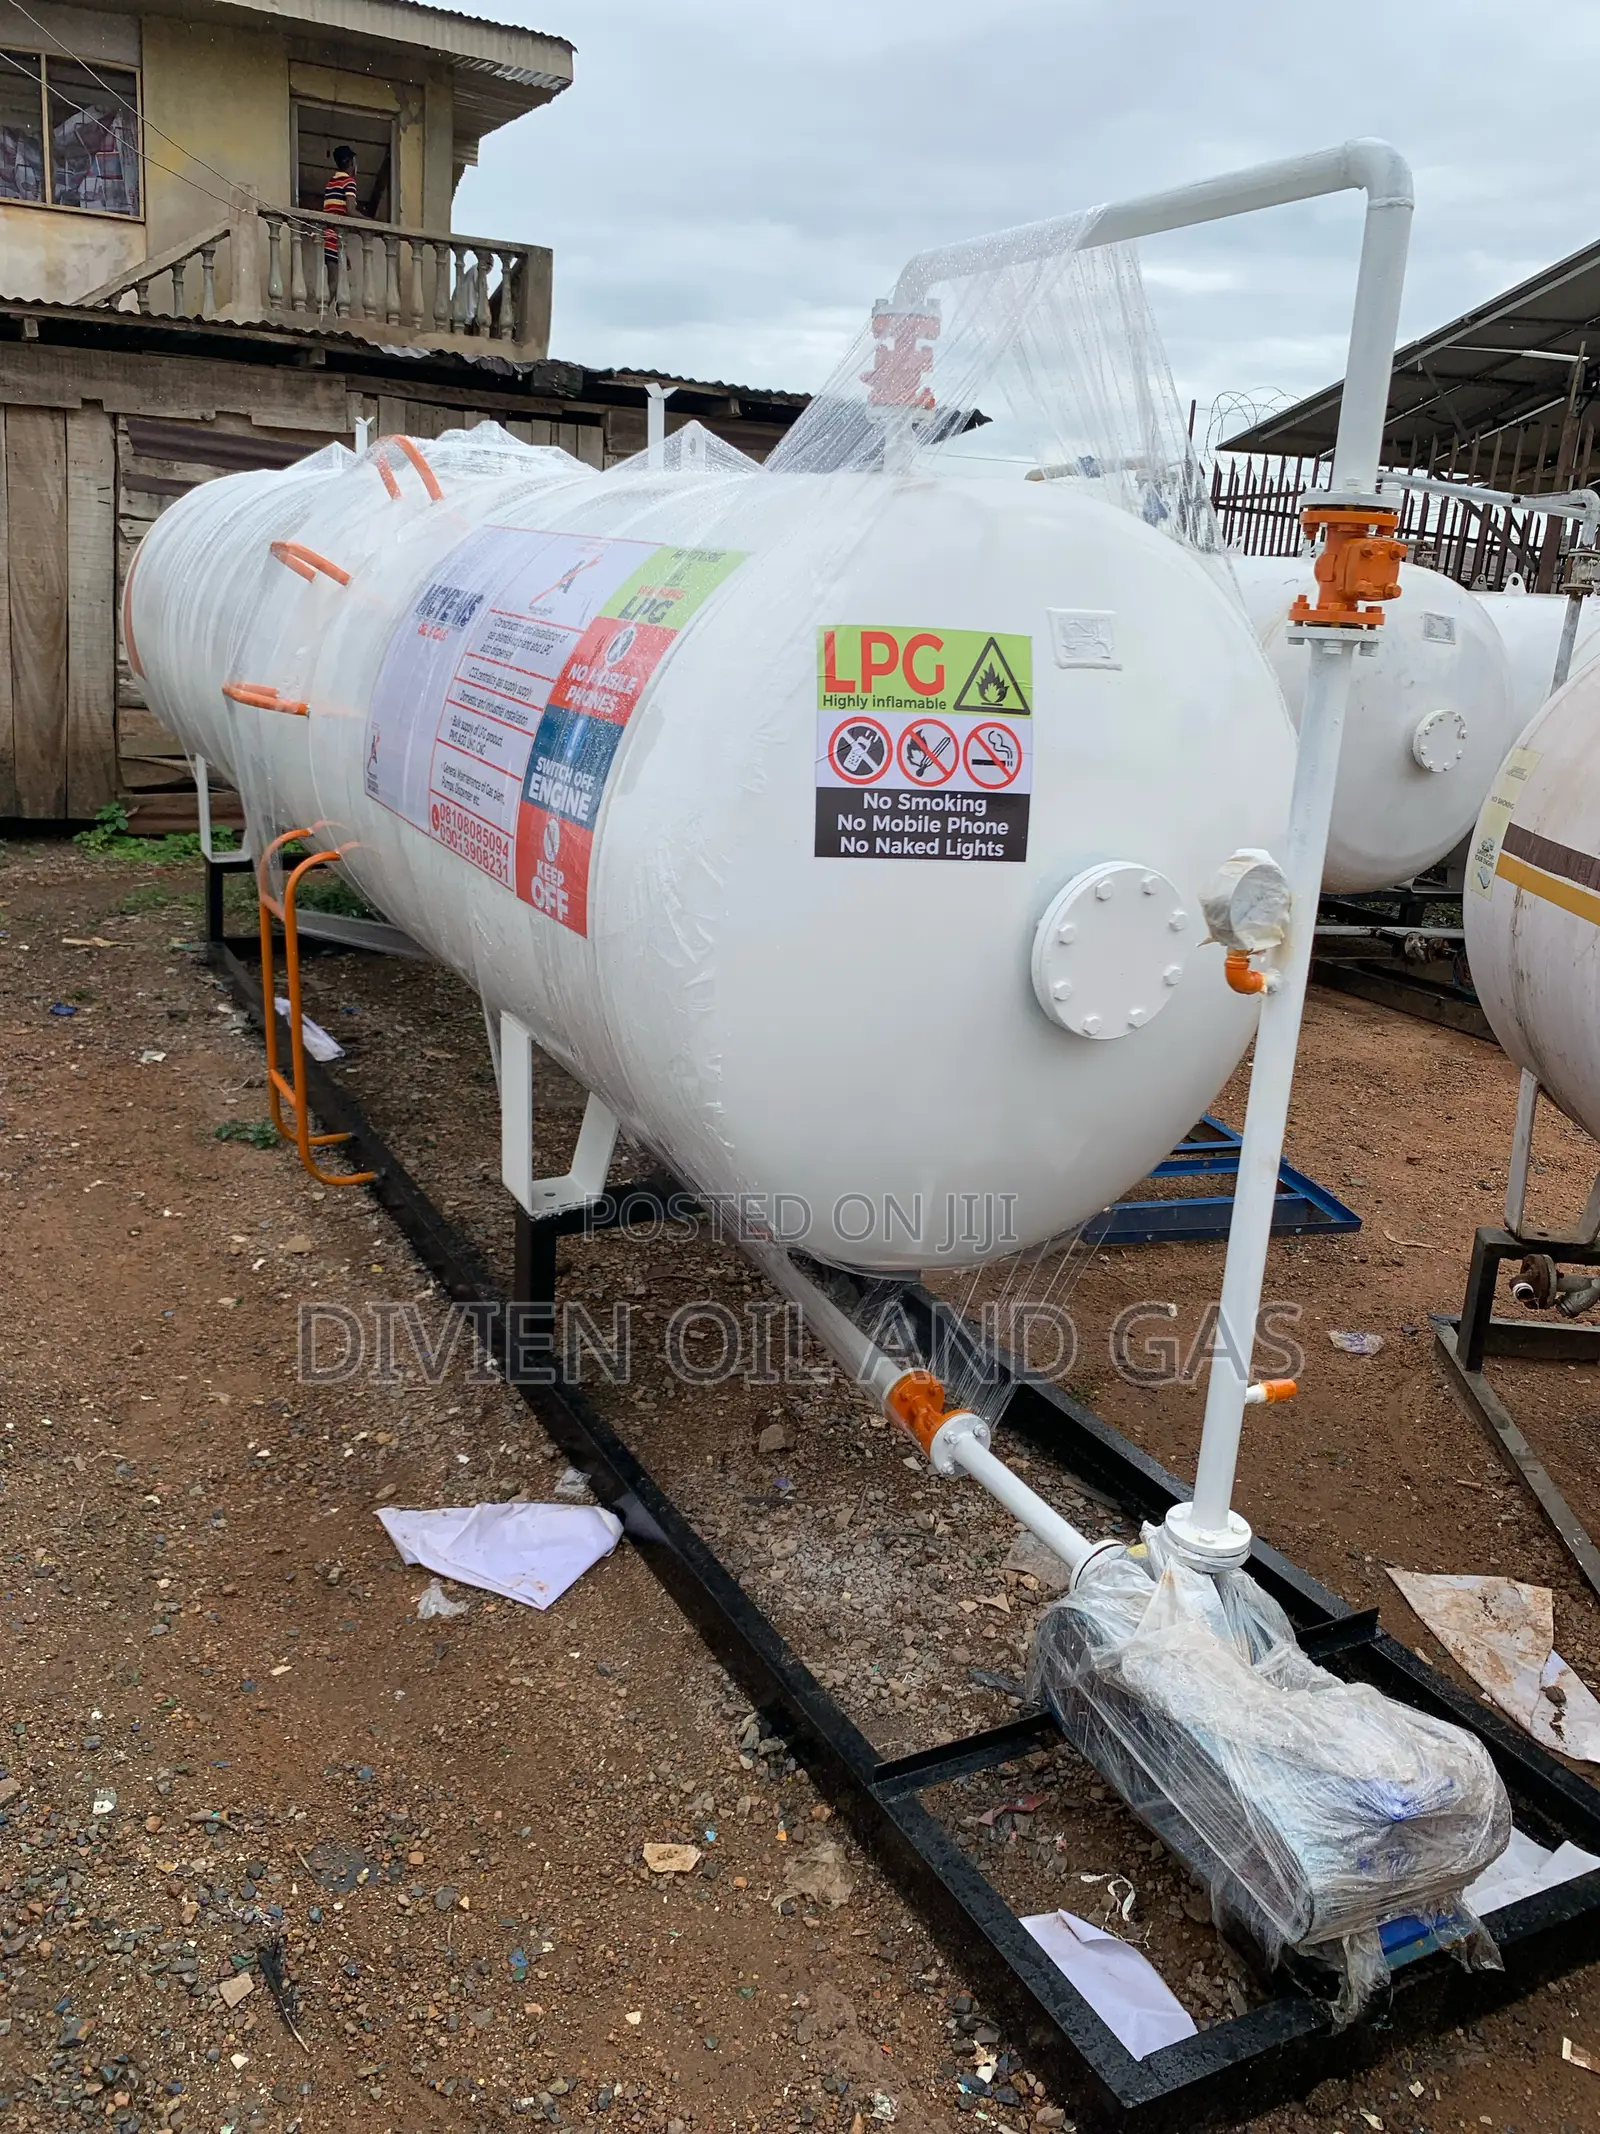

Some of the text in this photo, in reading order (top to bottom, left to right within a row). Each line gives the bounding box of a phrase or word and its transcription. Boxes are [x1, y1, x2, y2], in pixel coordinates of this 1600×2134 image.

[617, 596, 675, 624] LPG
[824, 630, 945, 696] LPG
[568, 663, 638, 695] NO MOBILE
[564, 685, 619, 714] PHONES
[823, 694, 947, 710] Highly inflamable
[536, 756, 596, 791] SWITCH OFF
[528, 773, 593, 821] ENGINE
[863, 792, 987, 816] No Smoking
[440, 803, 509, 861] 08108085094
[837, 814, 1009, 835] No Mobile Phone
[440, 823, 509, 883] 09013908231
[840, 836, 1004, 859] No Naked Lights
[537, 859, 565, 887] KEEP
[531, 875, 569, 920] OFF
